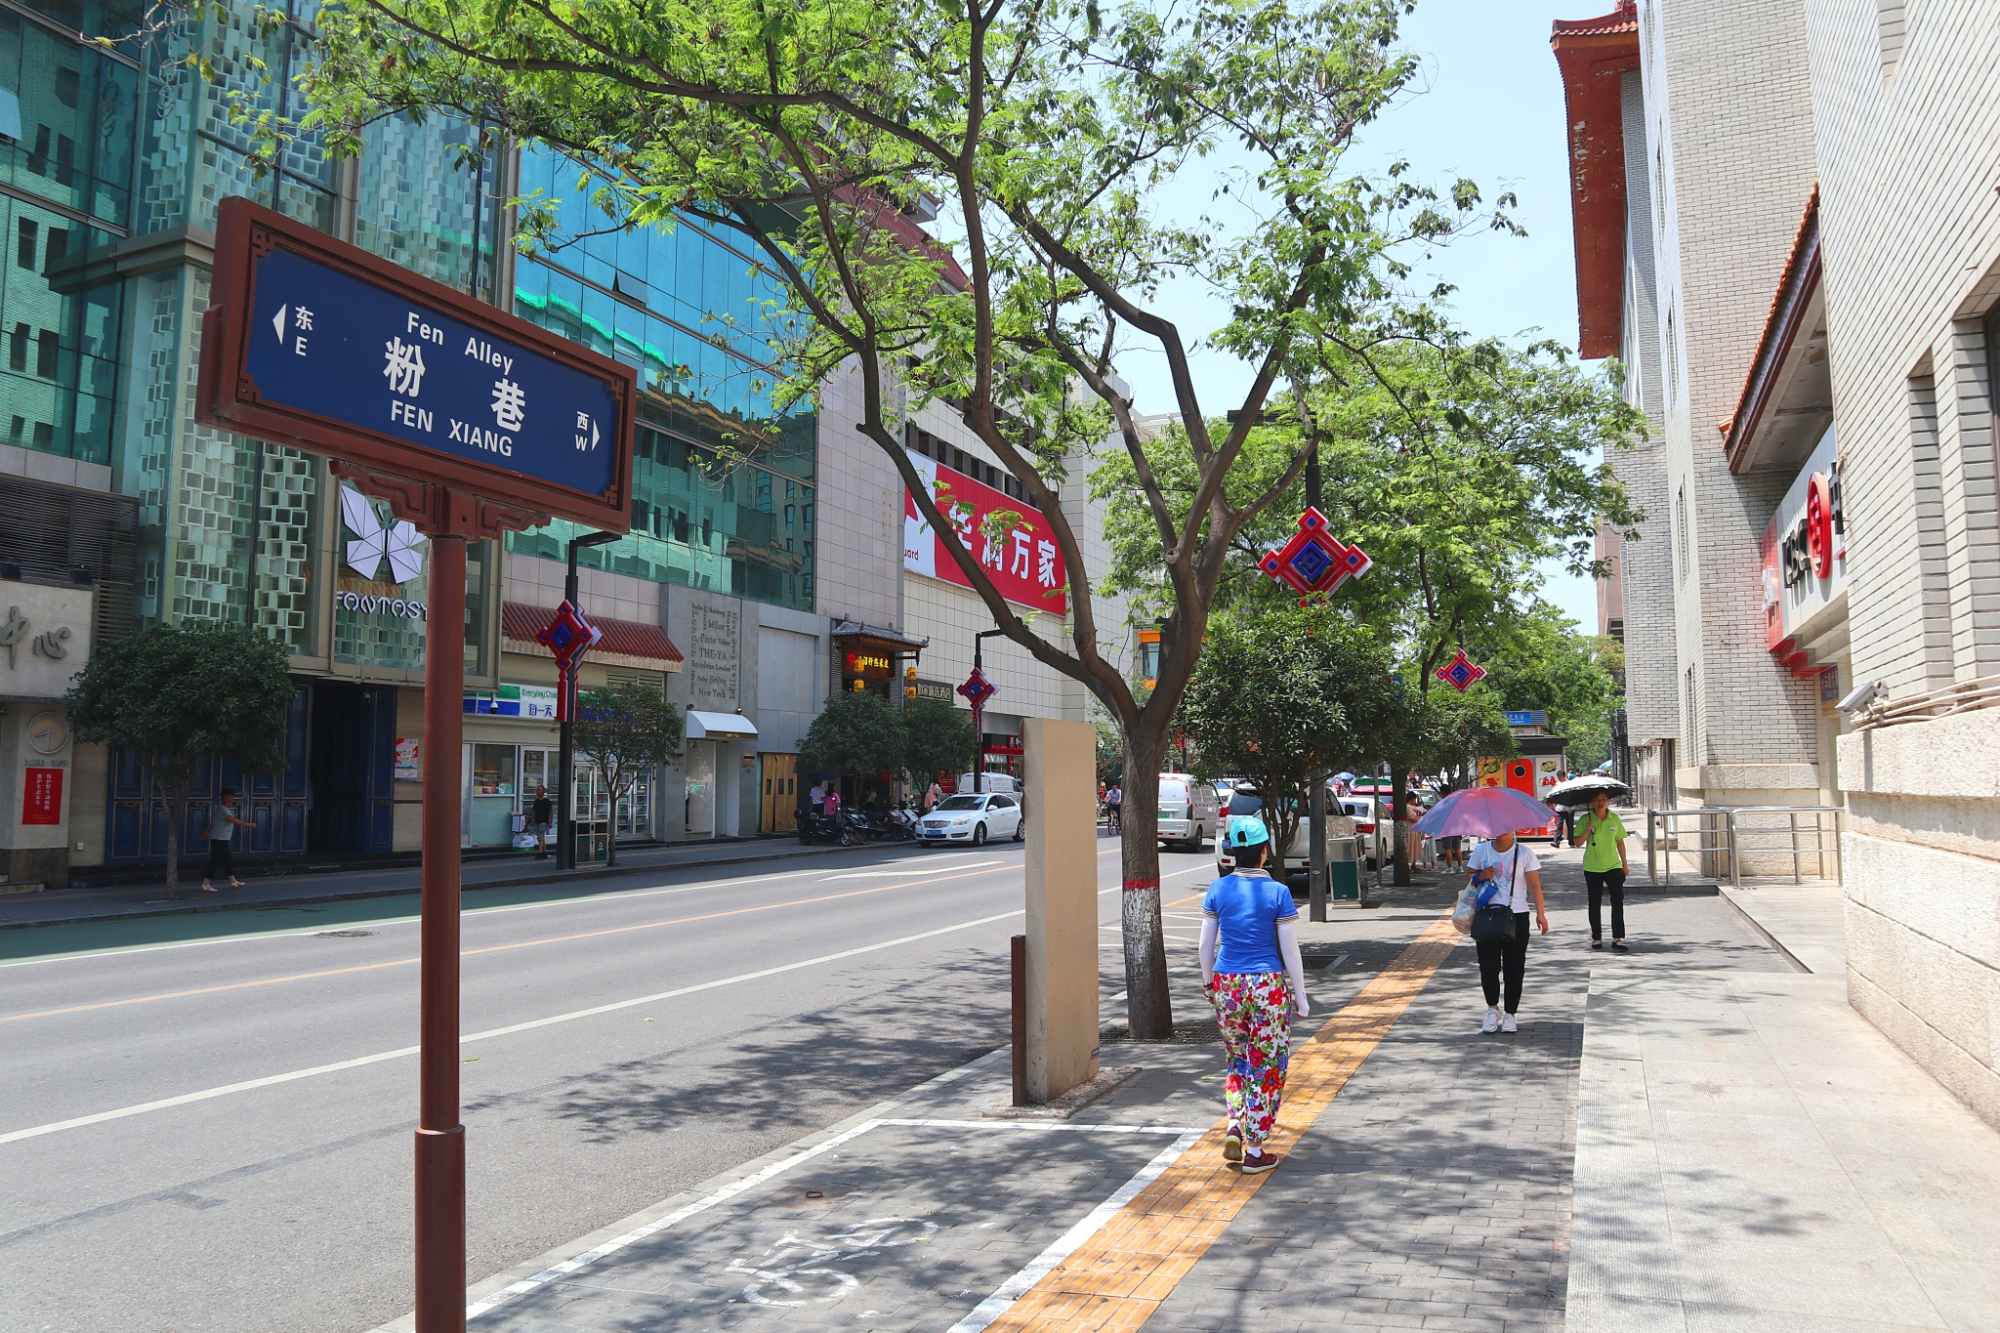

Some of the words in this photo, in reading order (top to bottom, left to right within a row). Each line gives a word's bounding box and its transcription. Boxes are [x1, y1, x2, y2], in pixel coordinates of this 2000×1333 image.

[295, 306, 314, 331] 东
[295, 336, 308, 357] E
[407, 311, 444, 346] Fen
[464, 337, 513, 376] Alley
[382, 336, 526, 433] 粉巷
[391, 399, 433, 433] FEN
[448, 418, 513, 457] XIANG
[577, 410, 590, 431] 西
[575, 434, 588, 451] W
[708, 619, 725, 630] Milan
[700, 633, 717, 644] Paris
[699, 647, 728, 661] THE-YA
[698, 687, 712, 697] New
[712, 688, 726, 699] York
[528, 703, 553, 717] 每一天
